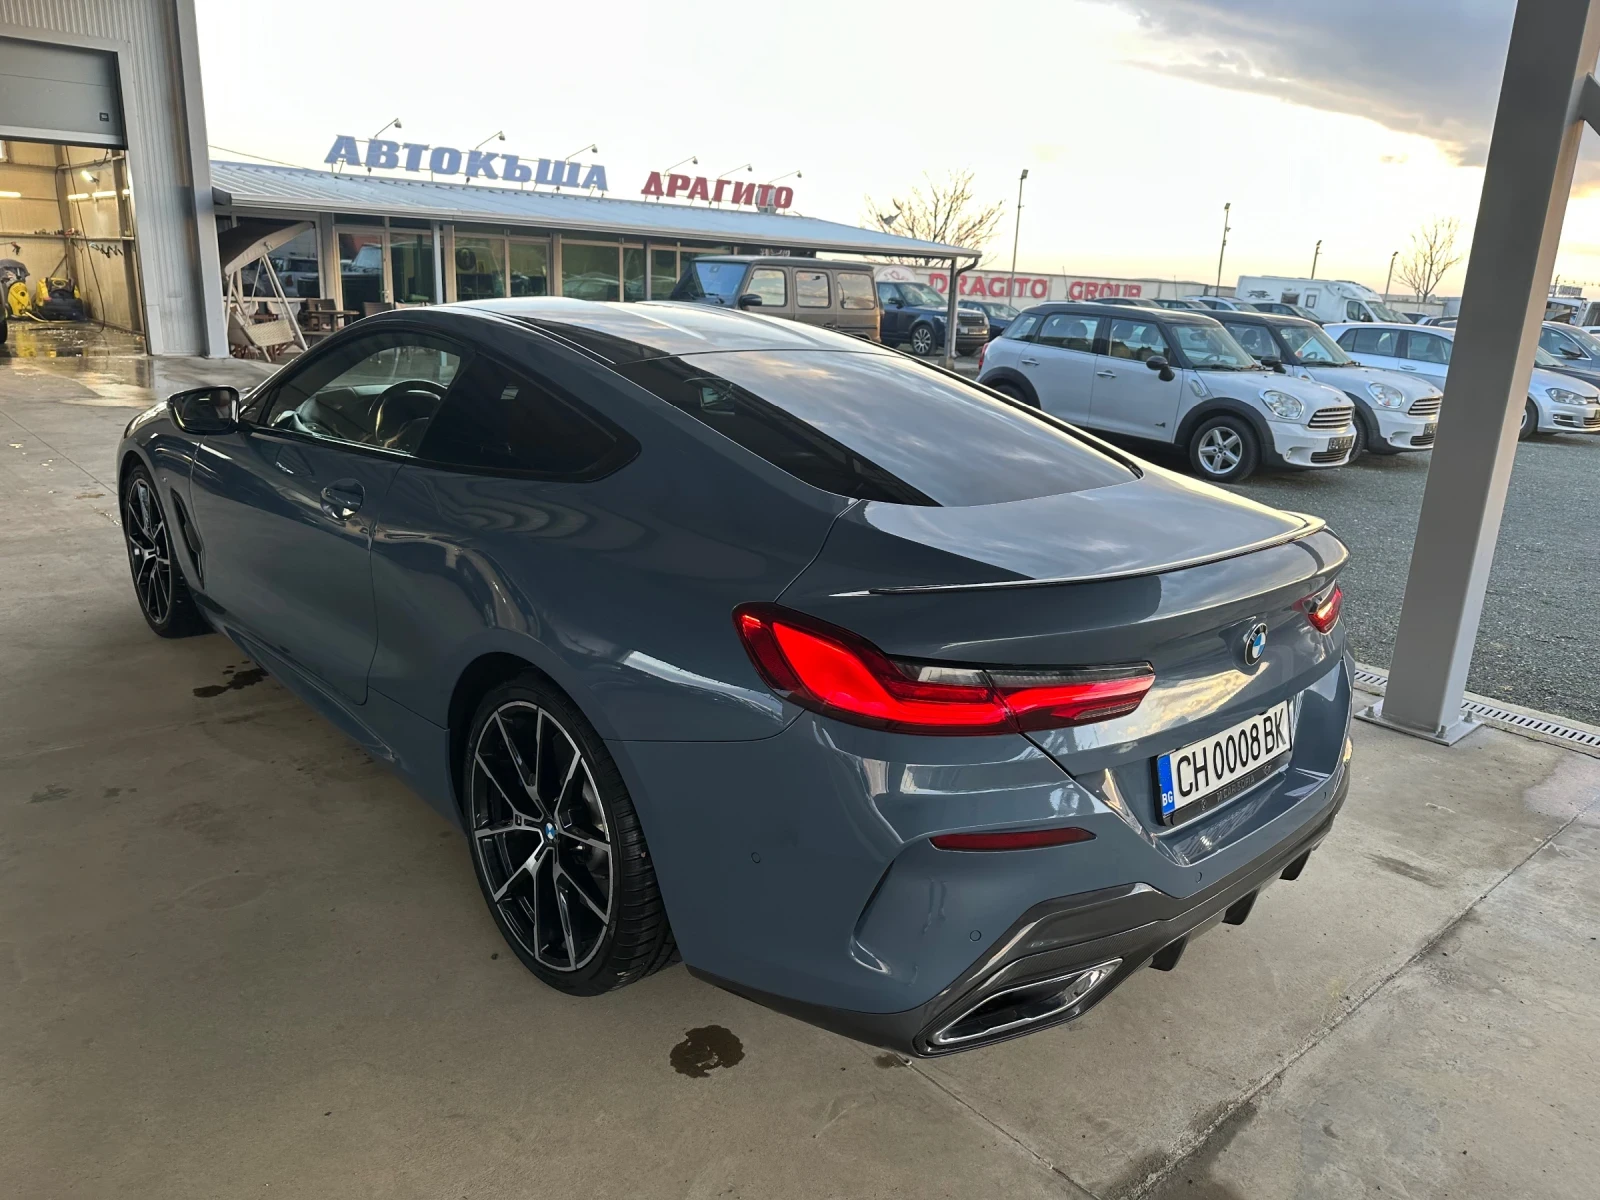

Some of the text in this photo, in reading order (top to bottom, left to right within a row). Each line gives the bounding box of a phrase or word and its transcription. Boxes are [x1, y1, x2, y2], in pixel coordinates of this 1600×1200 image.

[641, 171, 794, 208] ДРАГИТО
[929, 273, 1048, 299] DRAGITO
[1162, 791, 1174, 806] BG
